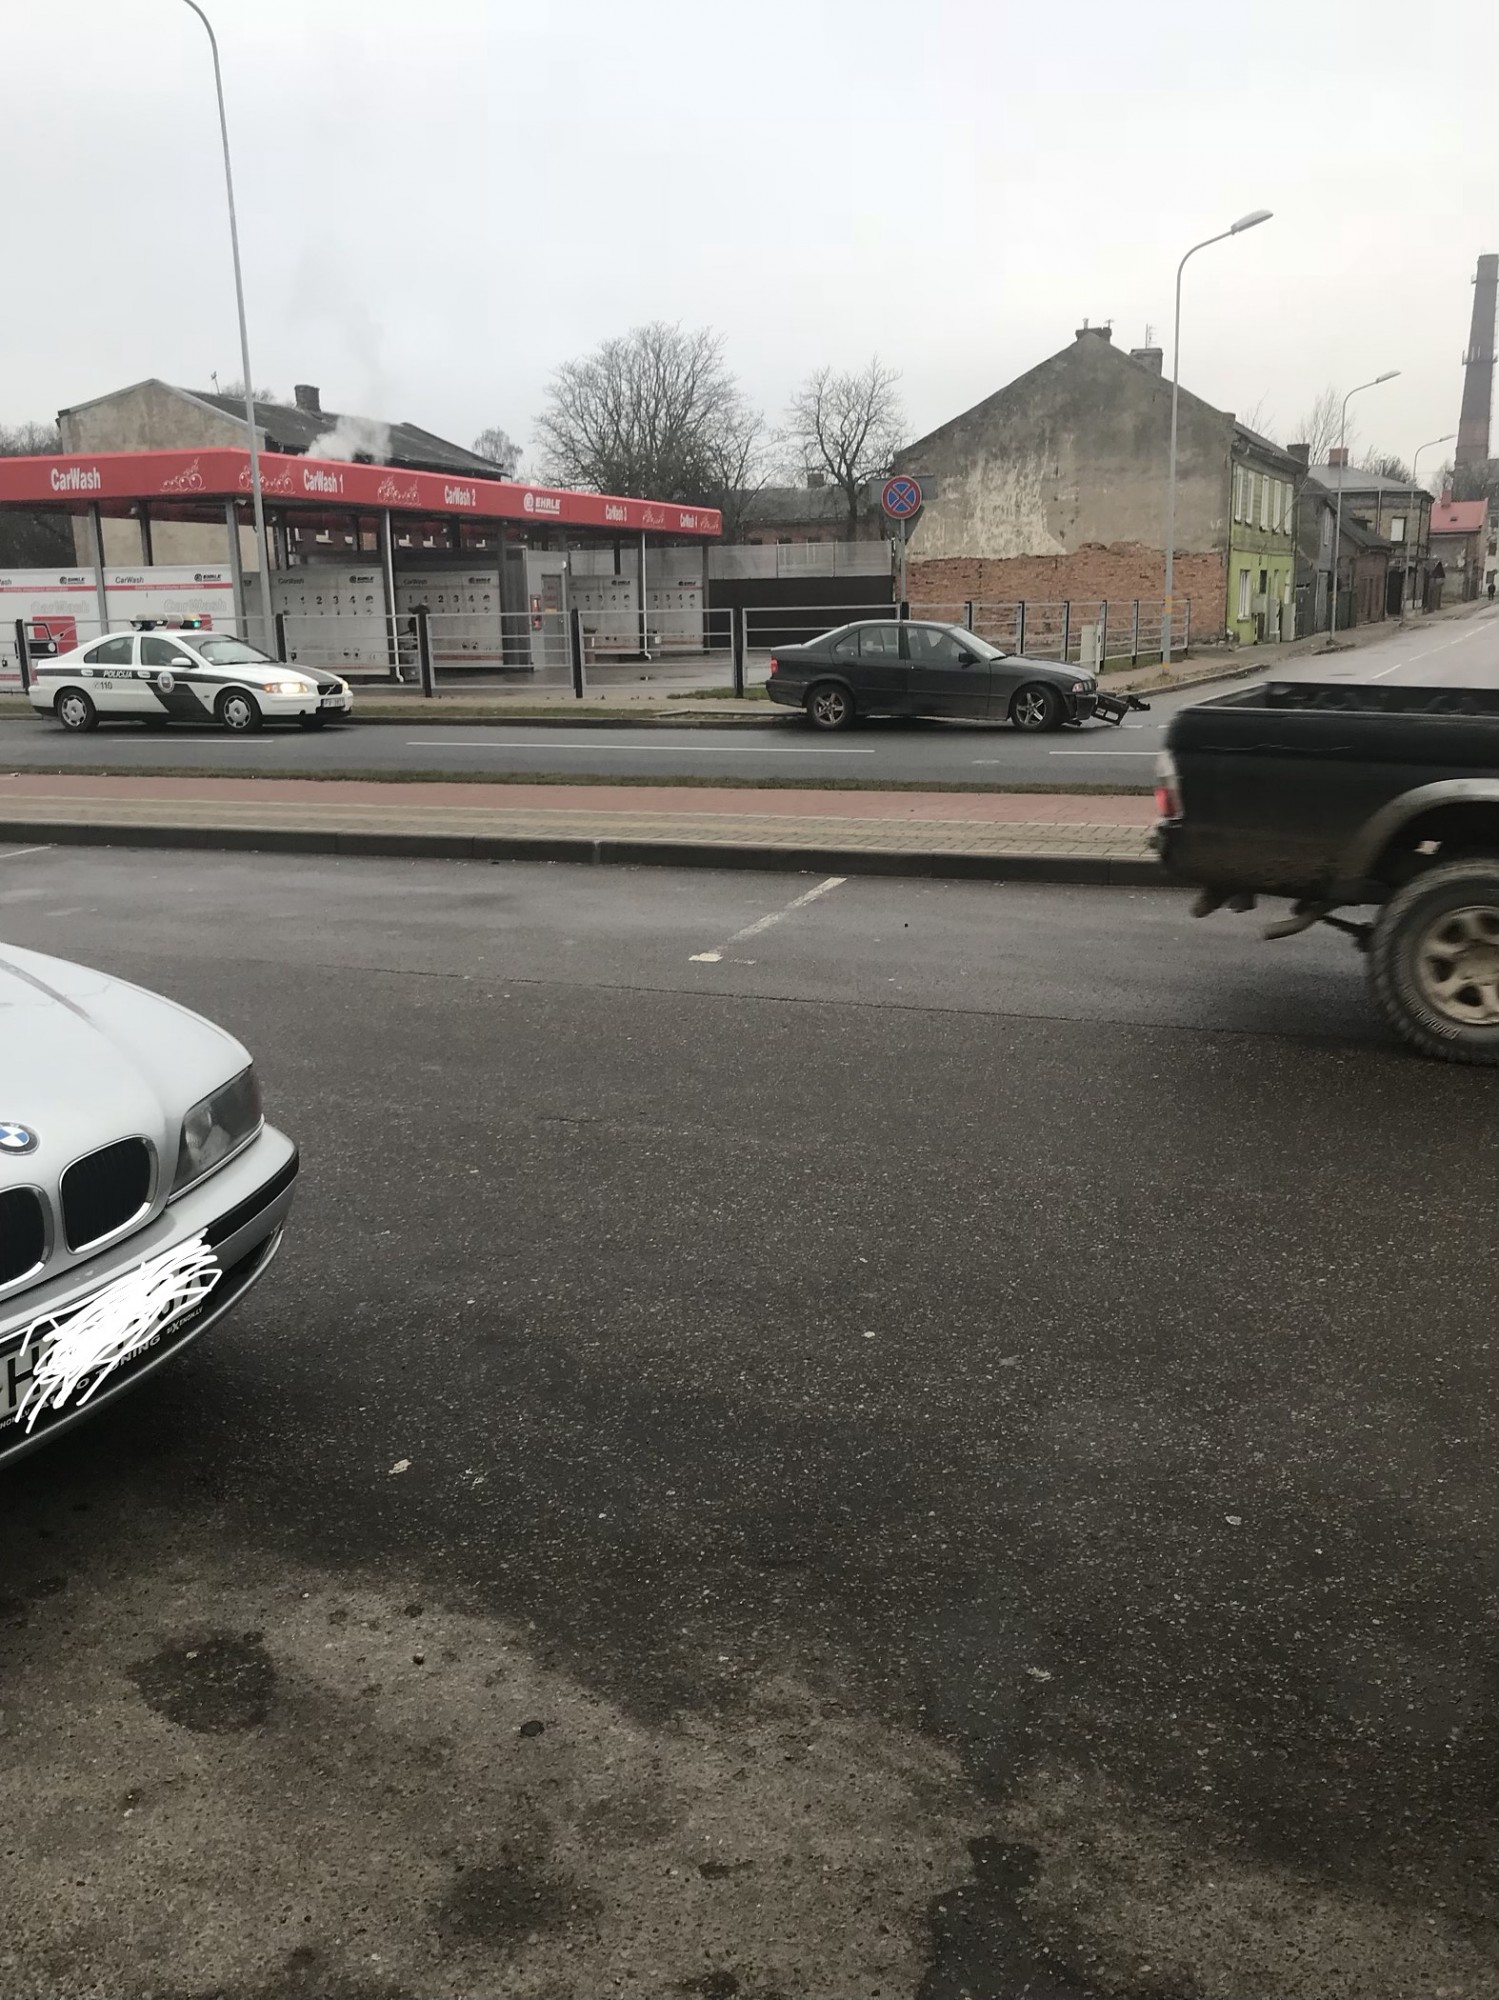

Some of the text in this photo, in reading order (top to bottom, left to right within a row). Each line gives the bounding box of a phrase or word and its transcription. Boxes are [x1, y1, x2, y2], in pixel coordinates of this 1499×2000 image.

[51, 467, 101, 491] CarWash
[303, 468, 344, 494] CarWash 1
[444, 485, 476, 507] CarWash 2
[535, 497, 561, 509] EHRLE
[605, 504, 624, 521] CarWash
[115, 576, 144, 584] CarWash
[438, 595, 444, 603] 2
[103, 670, 133, 679] POLICIJA
[100, 681, 113, 690] 110
